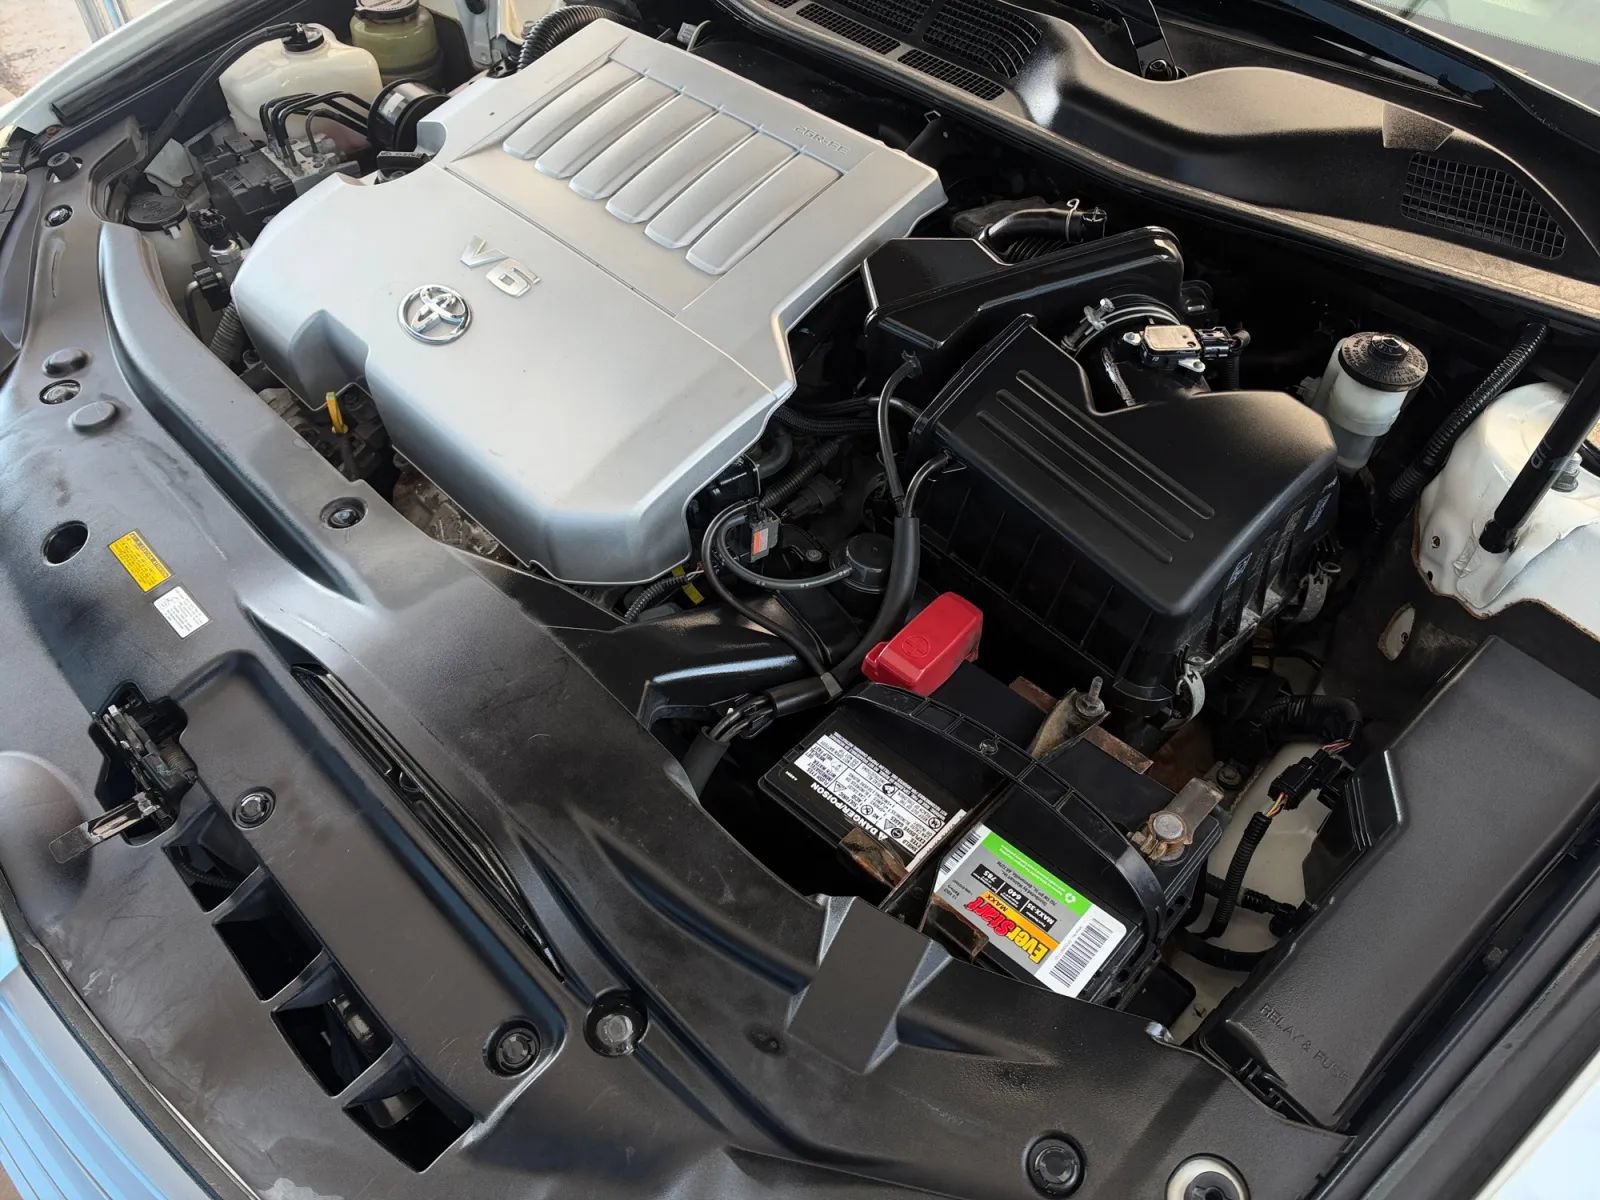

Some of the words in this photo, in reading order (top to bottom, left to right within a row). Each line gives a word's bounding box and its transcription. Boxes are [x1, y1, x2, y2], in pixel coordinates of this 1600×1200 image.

[459, 234, 541, 297] V6
[810, 781, 878, 835] DANGER/POISON
[902, 825, 925, 844] EXPLOSIVE
[982, 869, 996, 882] 785
[985, 893, 1008, 912] MAXX
[1007, 887, 1021, 900] 640
[1026, 902, 1054, 925] MAXX-35
[964, 893, 1049, 964] EverStart
[1260, 1003, 1305, 1042] RELAY
[1301, 1039, 1312, 1053] &
